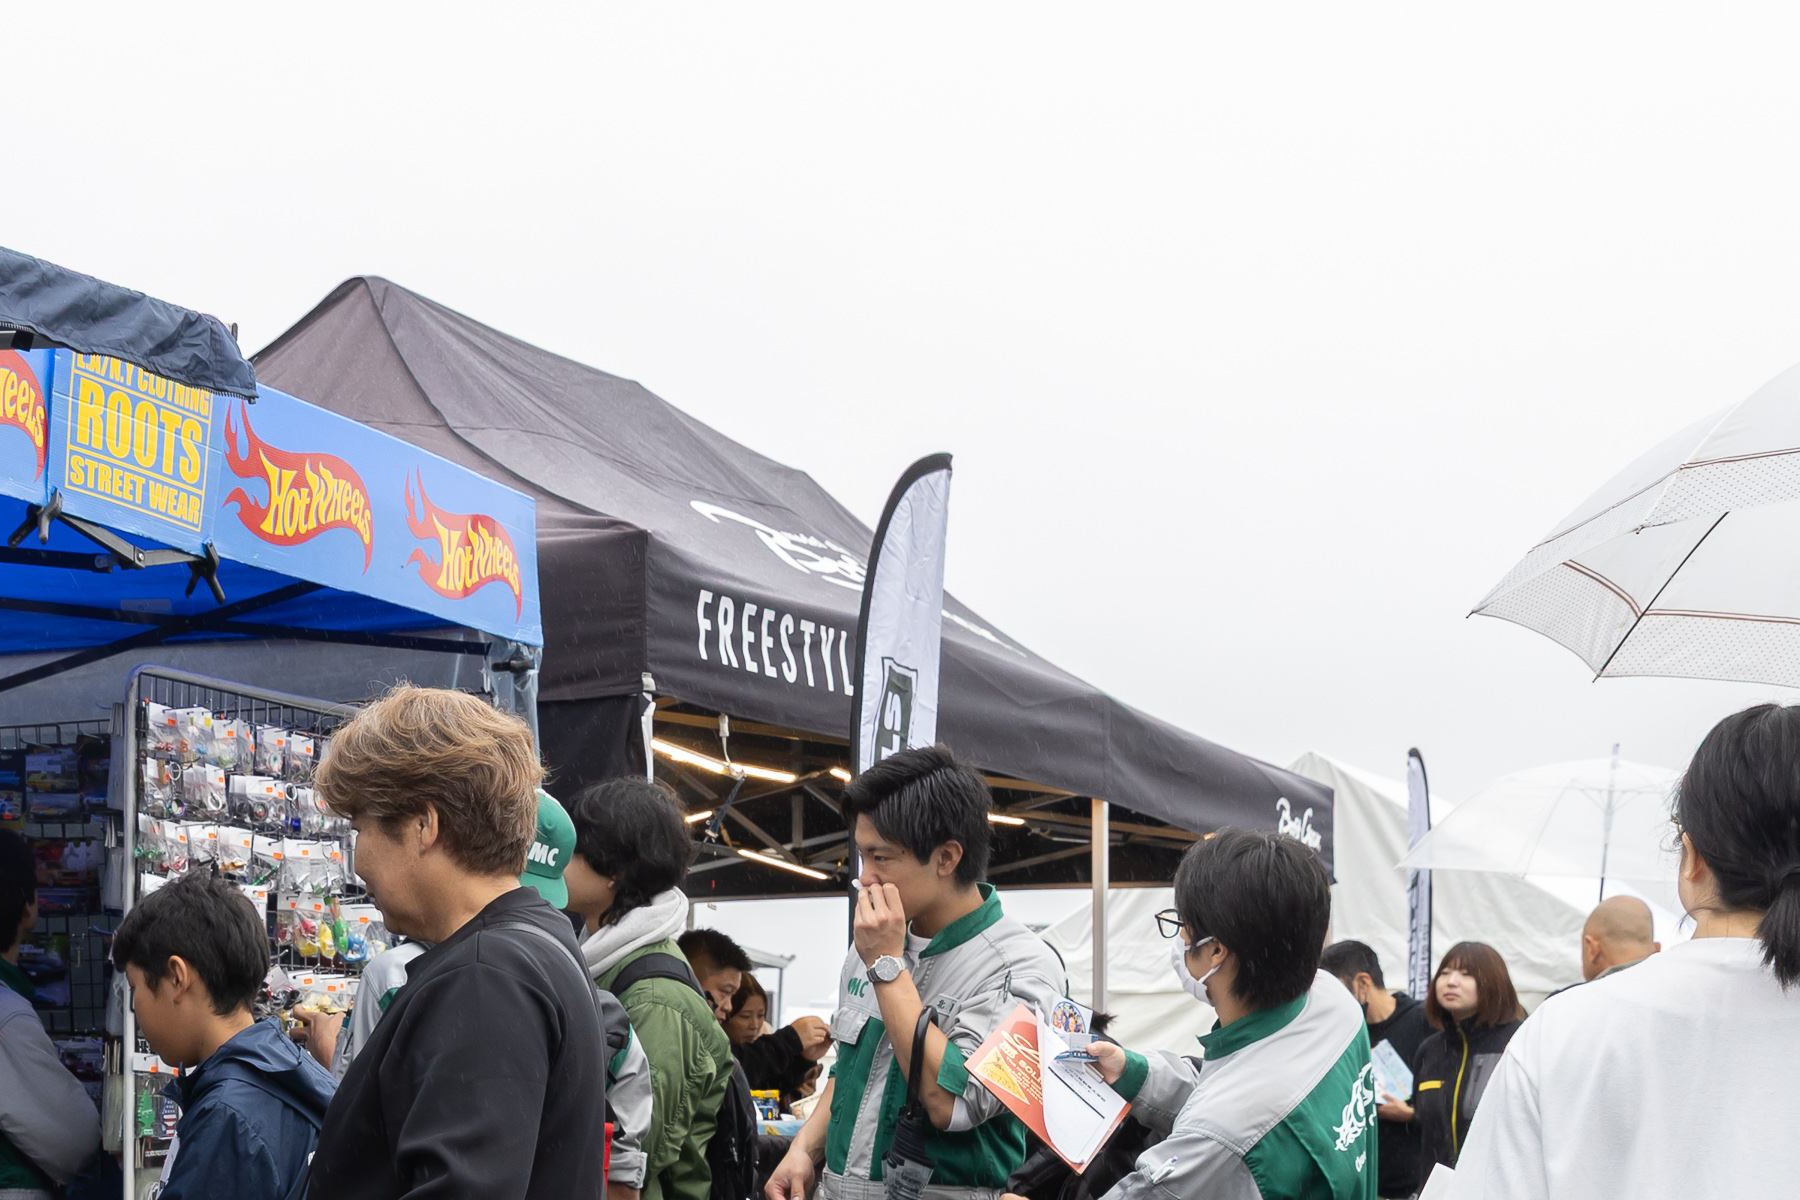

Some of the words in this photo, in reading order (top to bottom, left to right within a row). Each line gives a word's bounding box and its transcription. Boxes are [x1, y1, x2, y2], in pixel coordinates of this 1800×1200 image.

[137, 366, 210, 417] CLOTHING
[76, 377, 203, 484] ROOTS
[70, 455, 146, 504] STREET
[149, 480, 201, 525] WEAR
